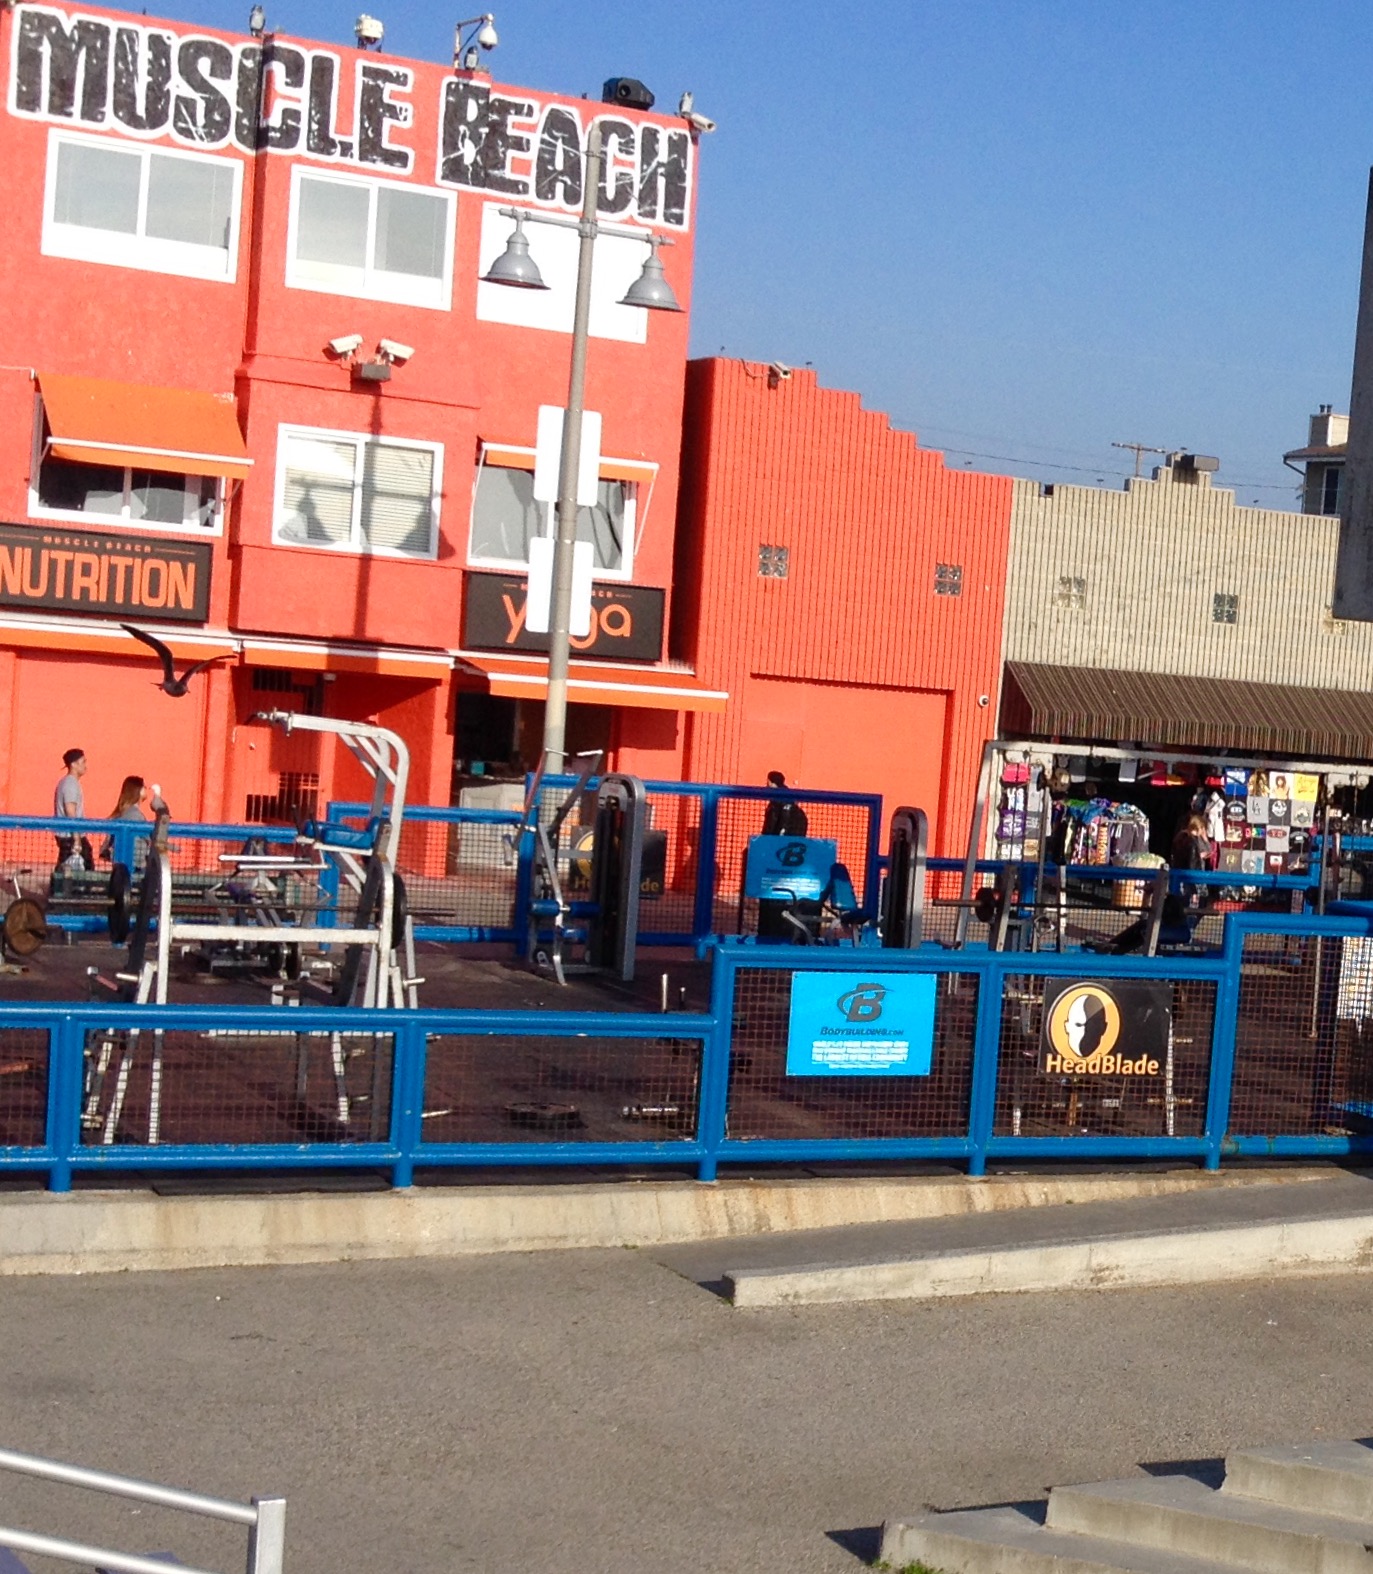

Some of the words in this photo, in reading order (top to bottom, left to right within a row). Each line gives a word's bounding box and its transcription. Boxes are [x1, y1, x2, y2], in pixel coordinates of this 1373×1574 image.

[12, 6, 412, 172] MUSCLE
[438, 79, 690, 228] BEACH
[0, 545, 196, 610] NUTRITION
[502, 594, 632, 649] yga
[1046, 1053, 1159, 1075] HeadBlade
